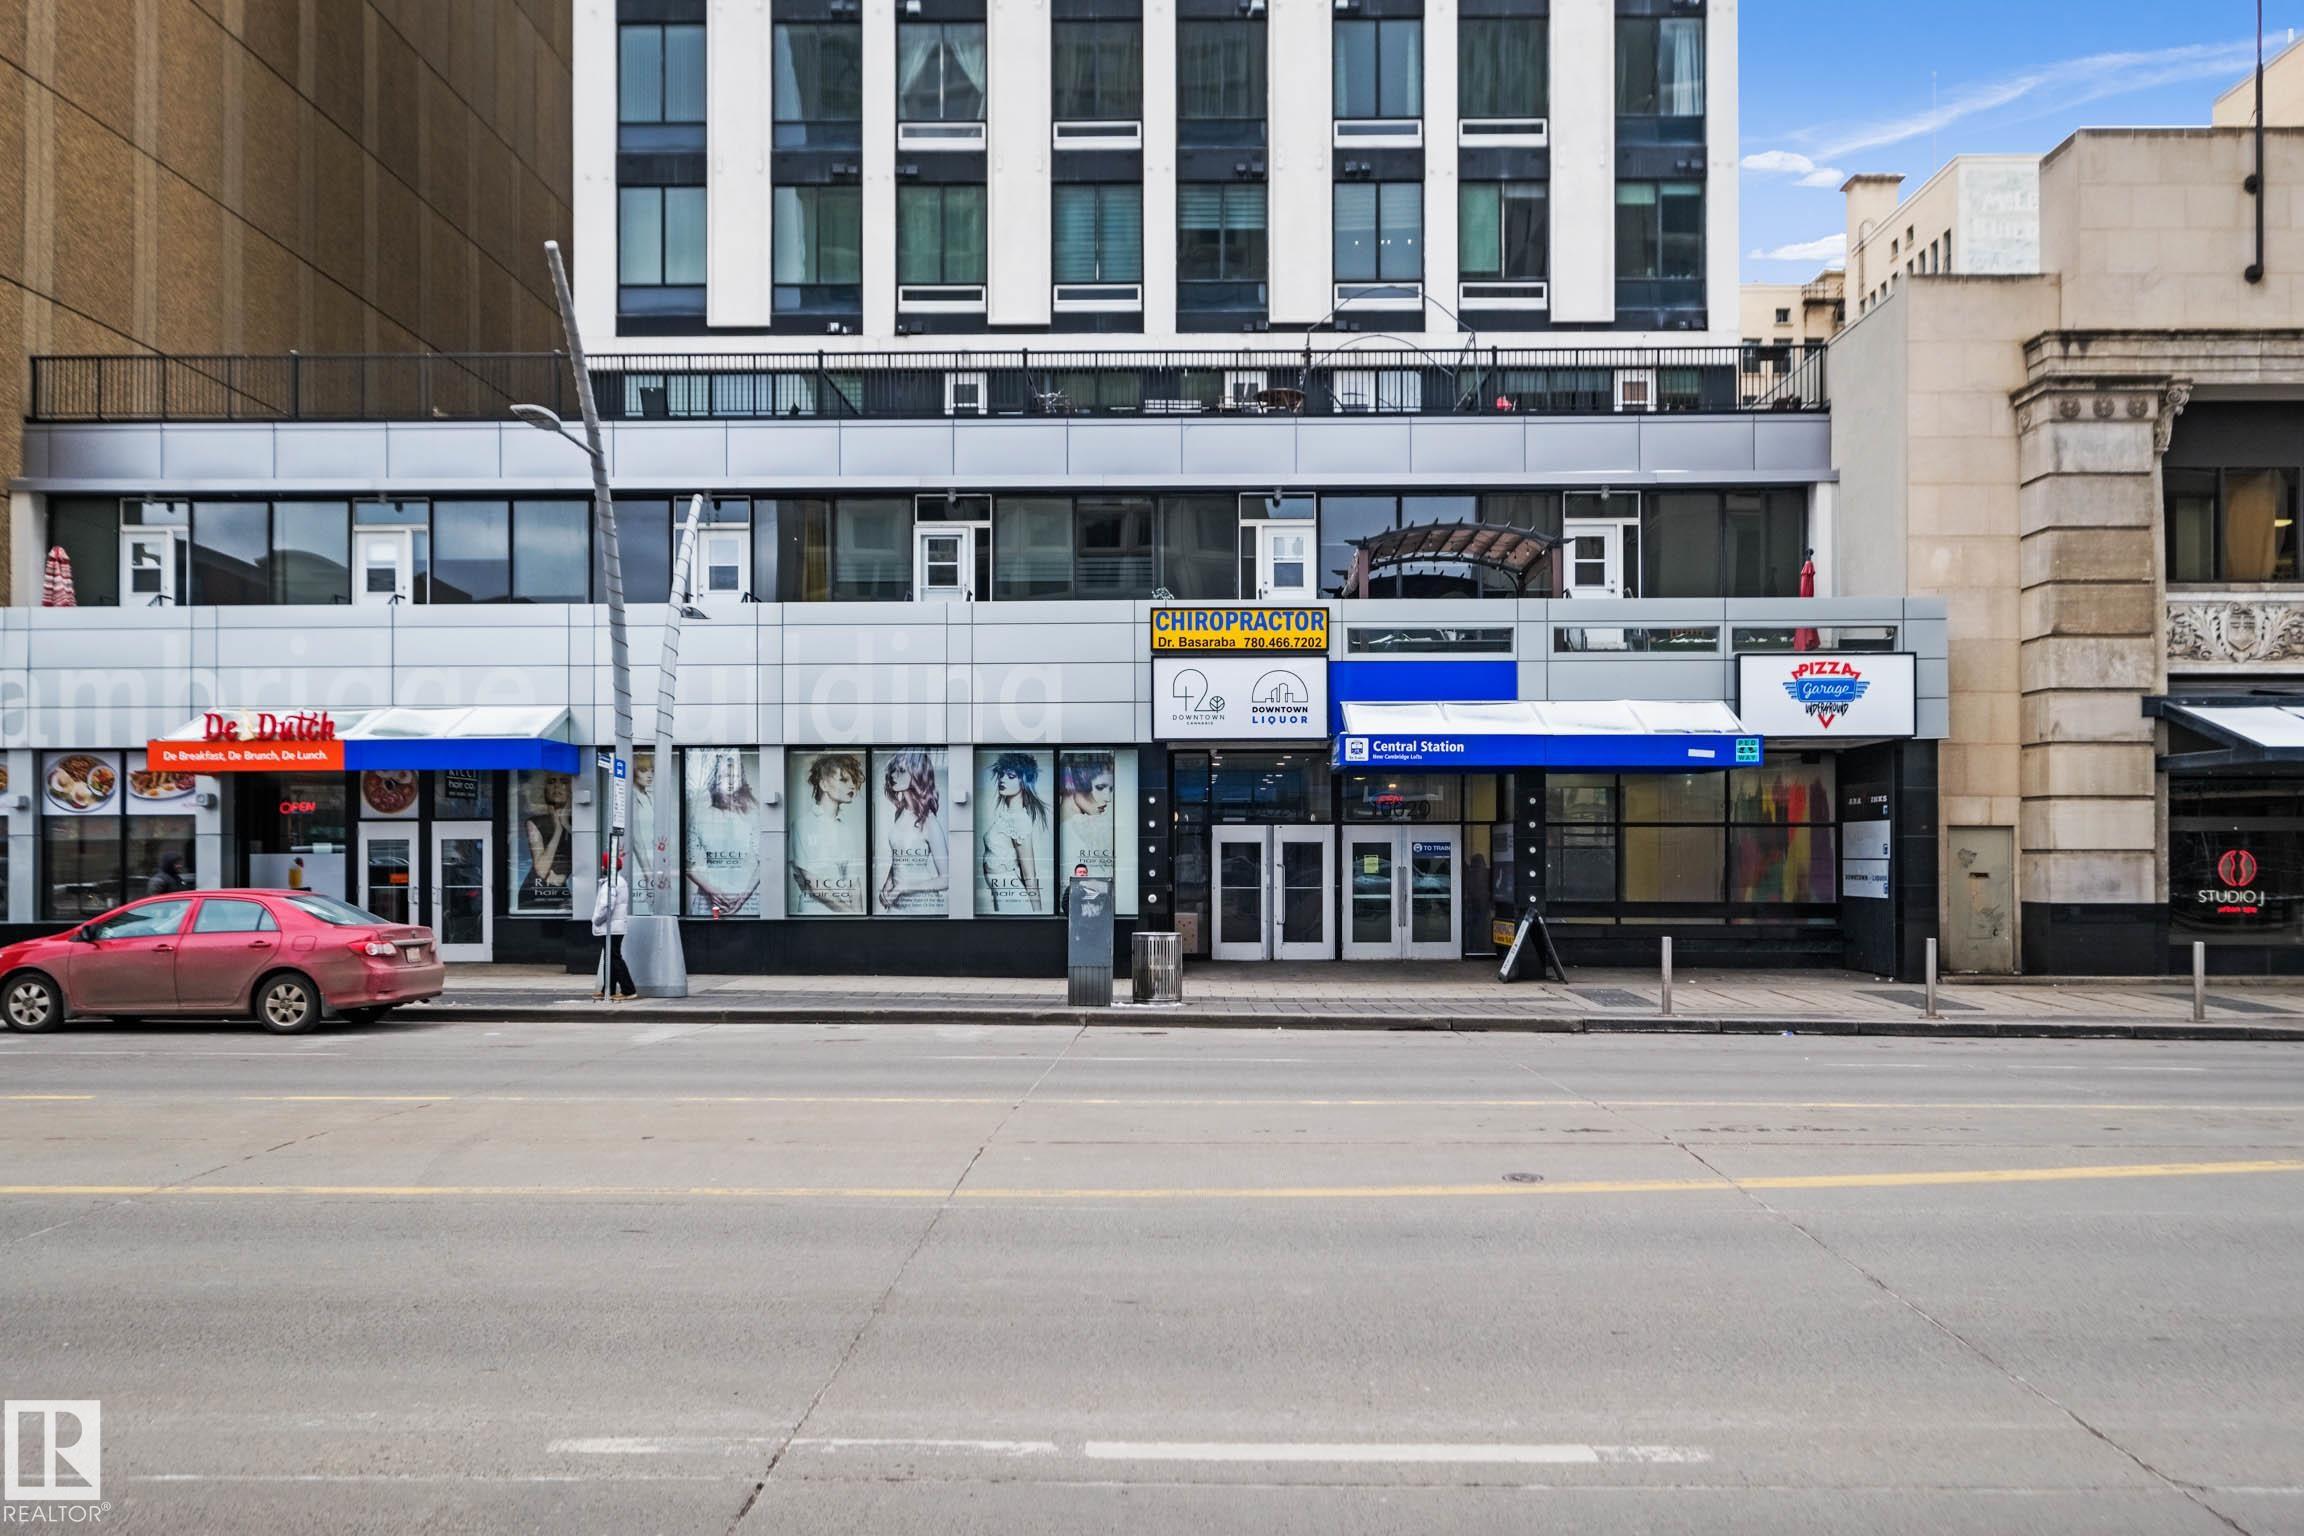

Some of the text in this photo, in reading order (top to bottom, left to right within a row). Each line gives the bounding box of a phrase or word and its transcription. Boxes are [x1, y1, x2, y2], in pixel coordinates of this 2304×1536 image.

[1155, 611, 1324, 631] CHIROPRACTOR
[1158, 637, 1322, 648] Dr. Basaraba 780.466.7202
[1799, 661, 1853, 677] PIZZA
[1802, 682, 1855, 699] Garage
[202, 710, 336, 741] De Dutch
[1252, 716, 1308, 725] LIQUOR
[1373, 740, 1465, 753] Central Station
[163, 750, 328, 762] De Breakfast, De Brunch, De Lunch.
[280, 801, 316, 815] OPEN
[706, 851, 742, 859] RICCI
[893, 848, 930, 856] RICCI
[1079, 849, 1113, 857] RICC
[804, 879, 853, 888] RICCI
[991, 878, 1040, 888] RICCI
[2198, 890, 2265, 907] STUDIO J
